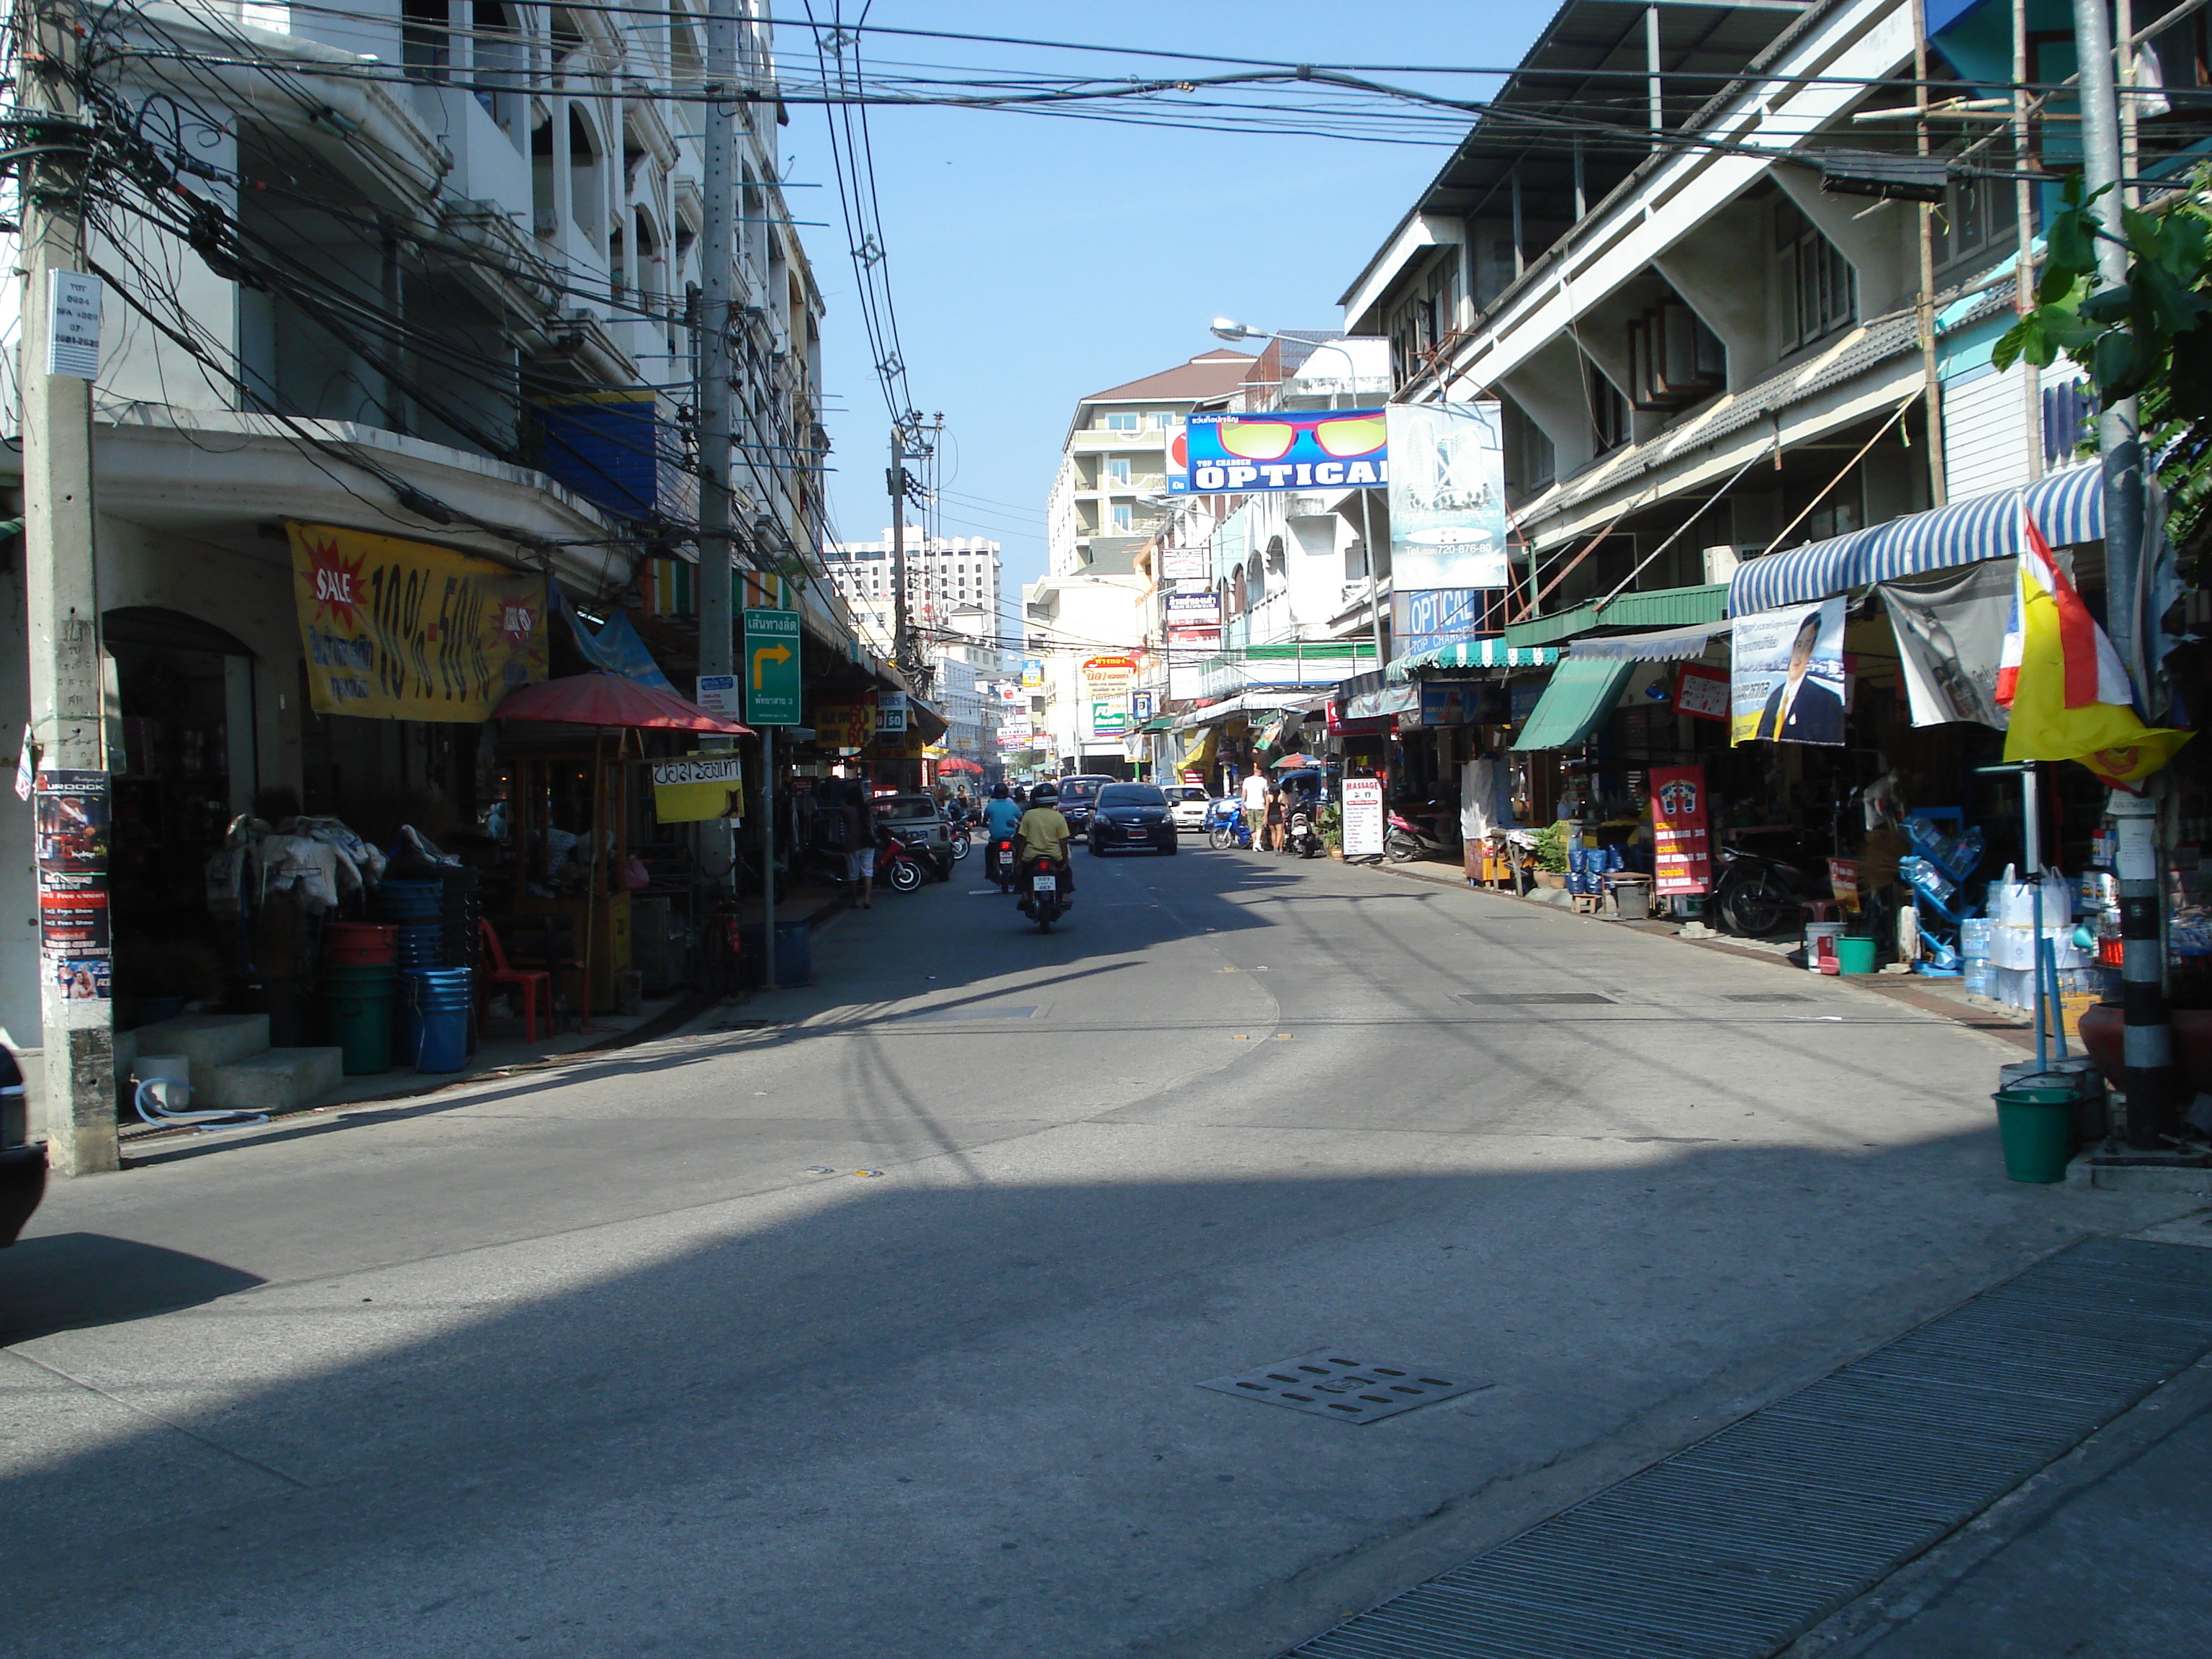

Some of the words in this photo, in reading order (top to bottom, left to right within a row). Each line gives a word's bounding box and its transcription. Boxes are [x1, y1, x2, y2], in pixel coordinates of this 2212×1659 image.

[317, 568, 351, 603] SALE
[1411, 590, 1475, 634] OPTICAL
[748, 613, 796, 631] เส้นทางลัด
[1412, 637, 1429, 653] TOP
[880, 697, 902, 706] NDRY
[1346, 781, 1378, 791] MASSAGE
